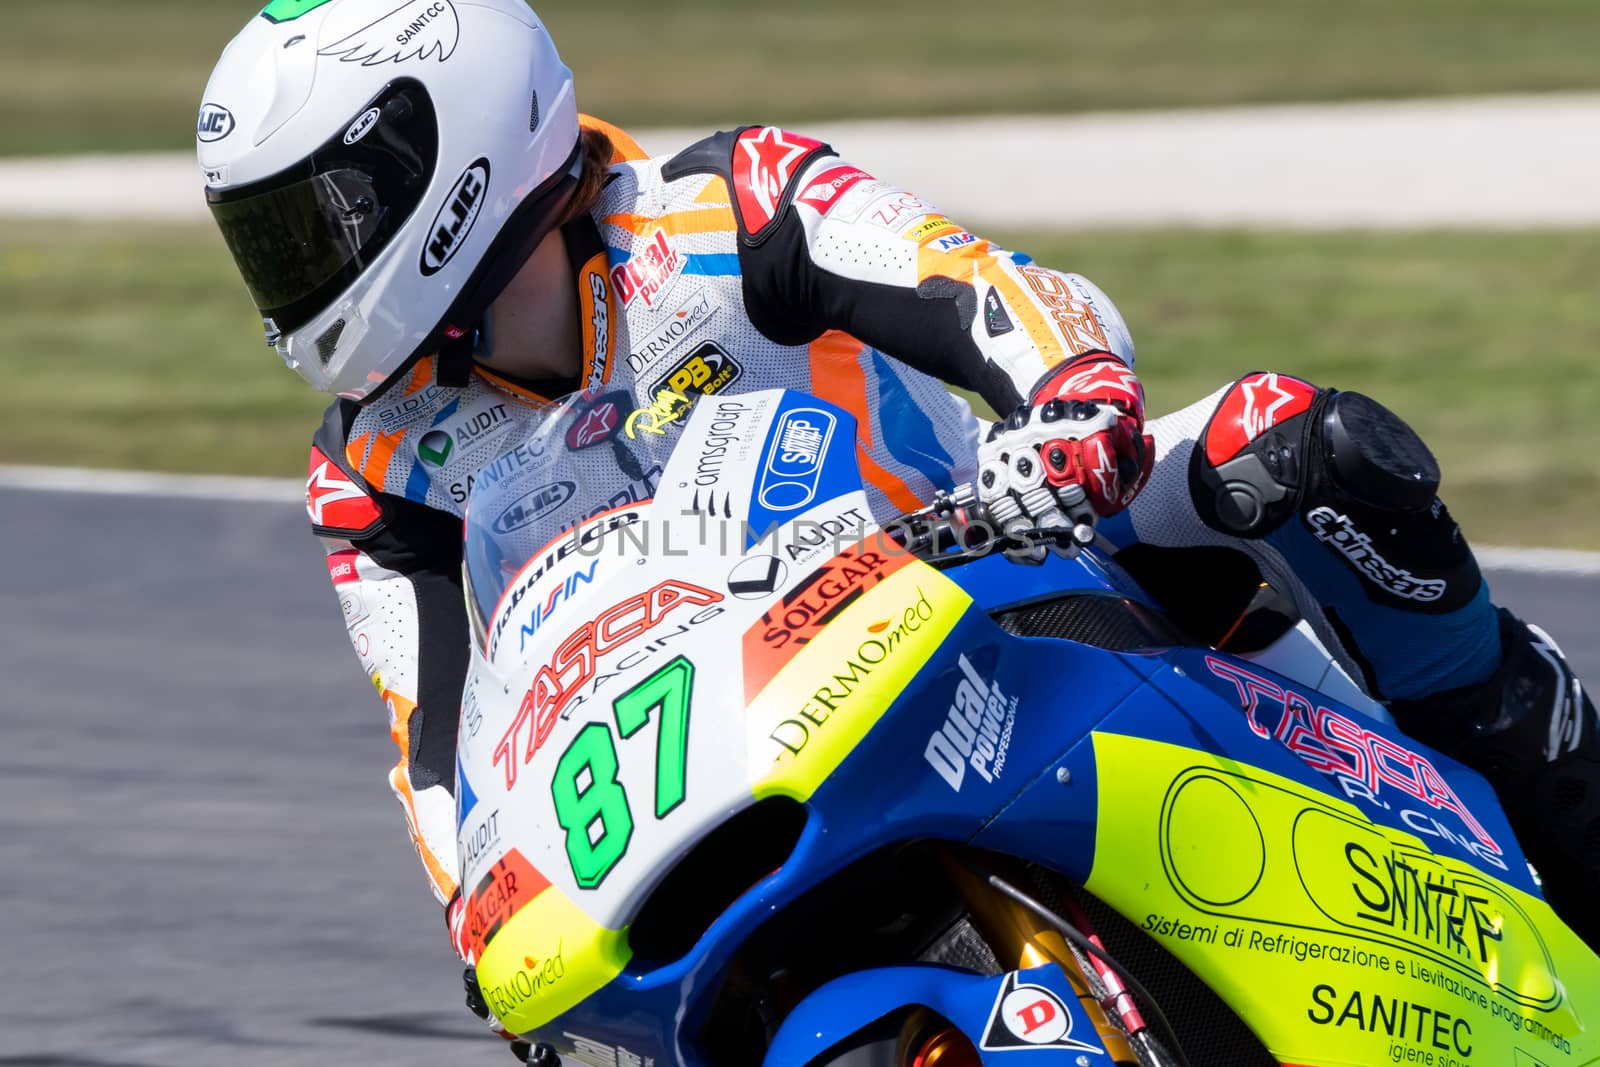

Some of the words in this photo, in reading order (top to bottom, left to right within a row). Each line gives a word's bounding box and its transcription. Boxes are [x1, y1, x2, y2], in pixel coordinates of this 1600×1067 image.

[396, 2, 445, 45] SAINT.CC
[349, 113, 373, 140] HJC
[428, 172, 482, 263] HJC
[626, 293, 710, 374] DERMOmed
[668, 356, 712, 394] PB
[456, 404, 508, 445] AUDIT
[450, 437, 545, 504] SANITEC
[503, 485, 562, 530] HJC
[785, 508, 867, 560] AUDIT
[763, 552, 888, 649] SOLGAR
[493, 579, 725, 791] TASCA
[561, 605, 726, 721] RACING
[769, 585, 933, 757] DERMOmed
[924, 652, 989, 792] Dual
[992, 695, 1019, 779] PROFESSIONAL
[1205, 655, 1504, 856] TASCA
[551, 654, 695, 890] 87
[467, 808, 499, 863] AUDIT
[1337, 776, 1509, 871] RCING
[1016, 999, 1056, 1036] D
[1141, 913, 1219, 944] Sistemi
[1223, 927, 1243, 948] di
[1248, 930, 1390, 971] Refrigerazione
[1395, 962, 1406, 975] e
[1410, 959, 1488, 1009] Lievitazione
[1491, 1000, 1571, 1055] programmata
[1308, 984, 1473, 1058] SANITEC
[1388, 1039, 1434, 1067] igiene
